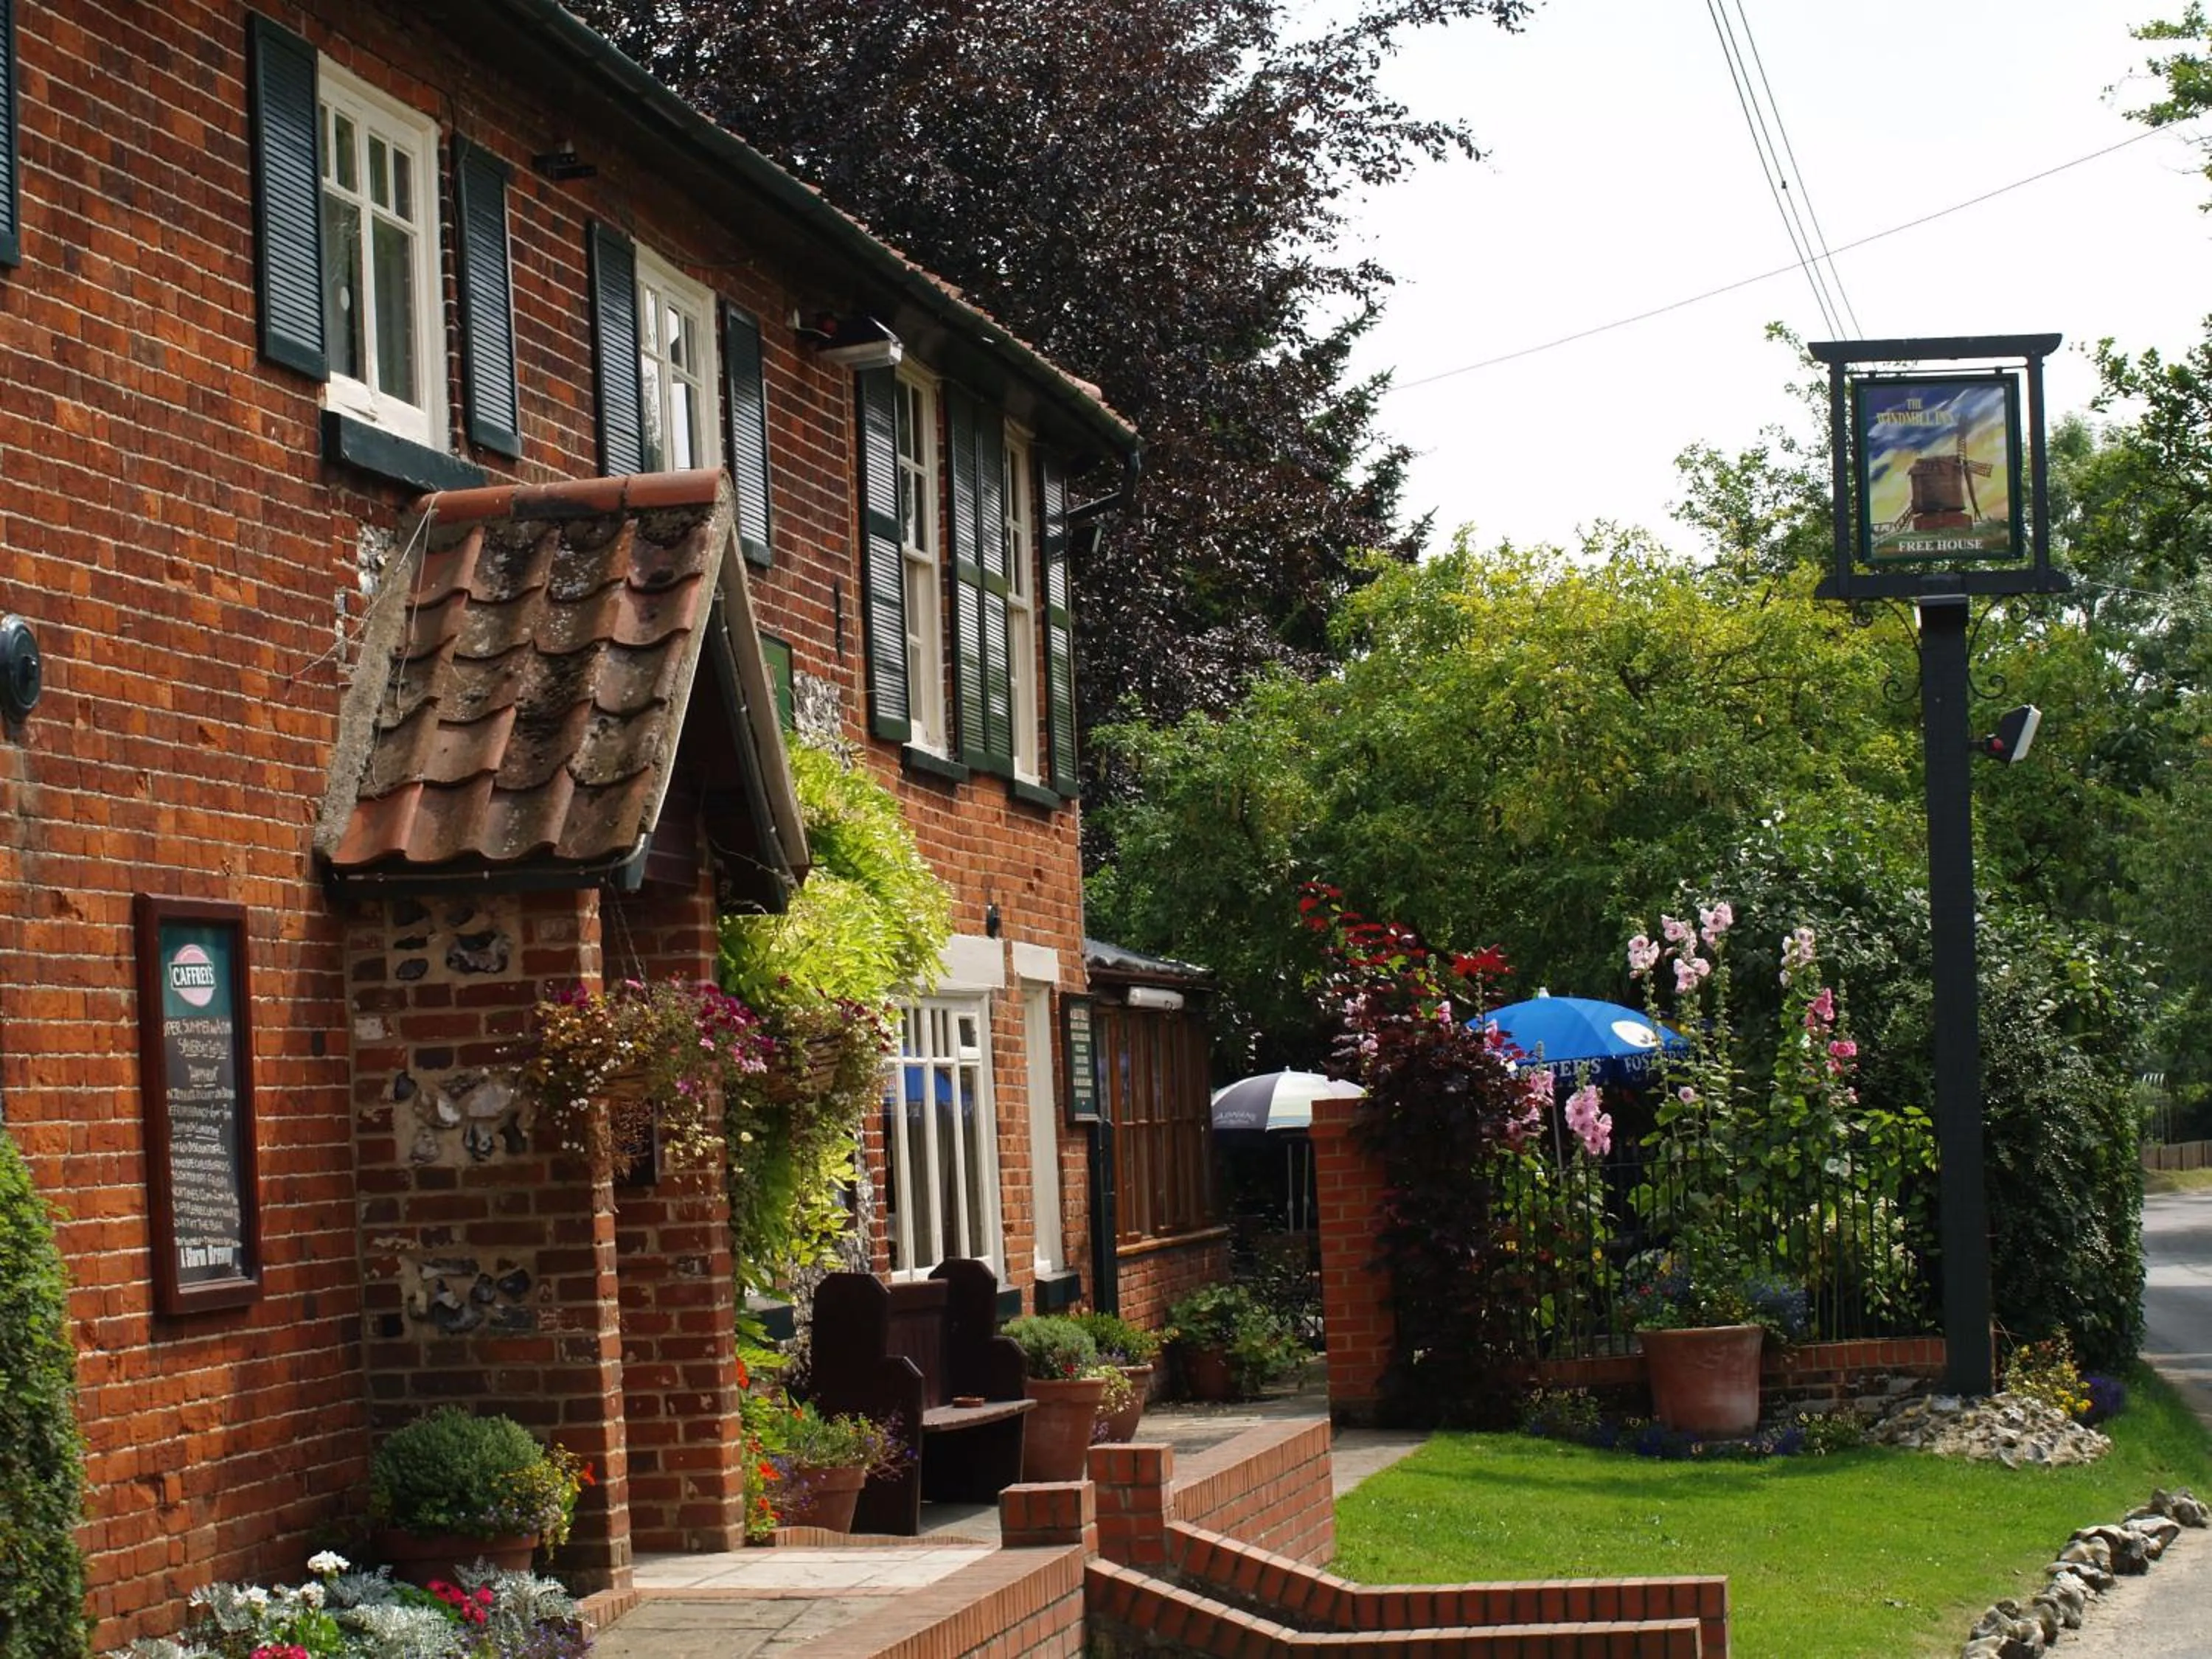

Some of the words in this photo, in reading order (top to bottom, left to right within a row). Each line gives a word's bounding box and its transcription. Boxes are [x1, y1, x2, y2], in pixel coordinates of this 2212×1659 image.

[1906, 398, 1923, 410] THE
[1876, 412, 1935, 426] WINDMILL
[1935, 411, 1956, 425] INN
[1899, 540, 1934, 552] FREE
[1937, 538, 1983, 552] HOUSE
[1624, 1050, 1688, 1073] FOSR'S
